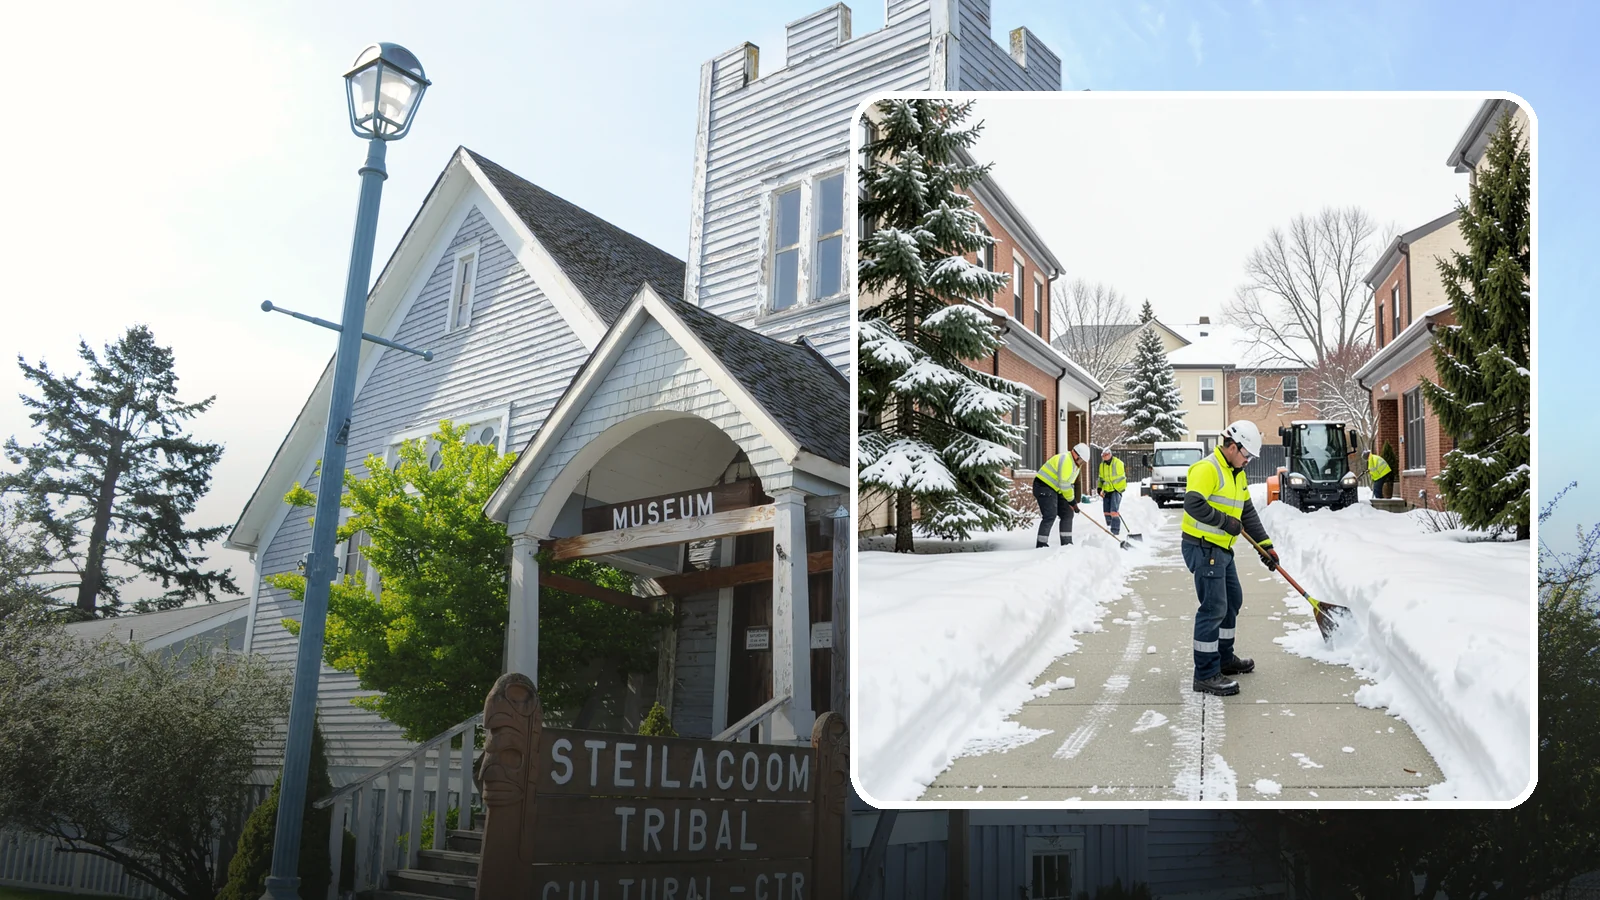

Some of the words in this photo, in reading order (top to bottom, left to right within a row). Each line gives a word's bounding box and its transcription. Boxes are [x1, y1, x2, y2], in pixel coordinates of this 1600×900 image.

[612, 491, 714, 530] MUSEUM
[551, 738, 810, 792] STEILACOOM
[614, 806, 758, 851] TRIBAL
